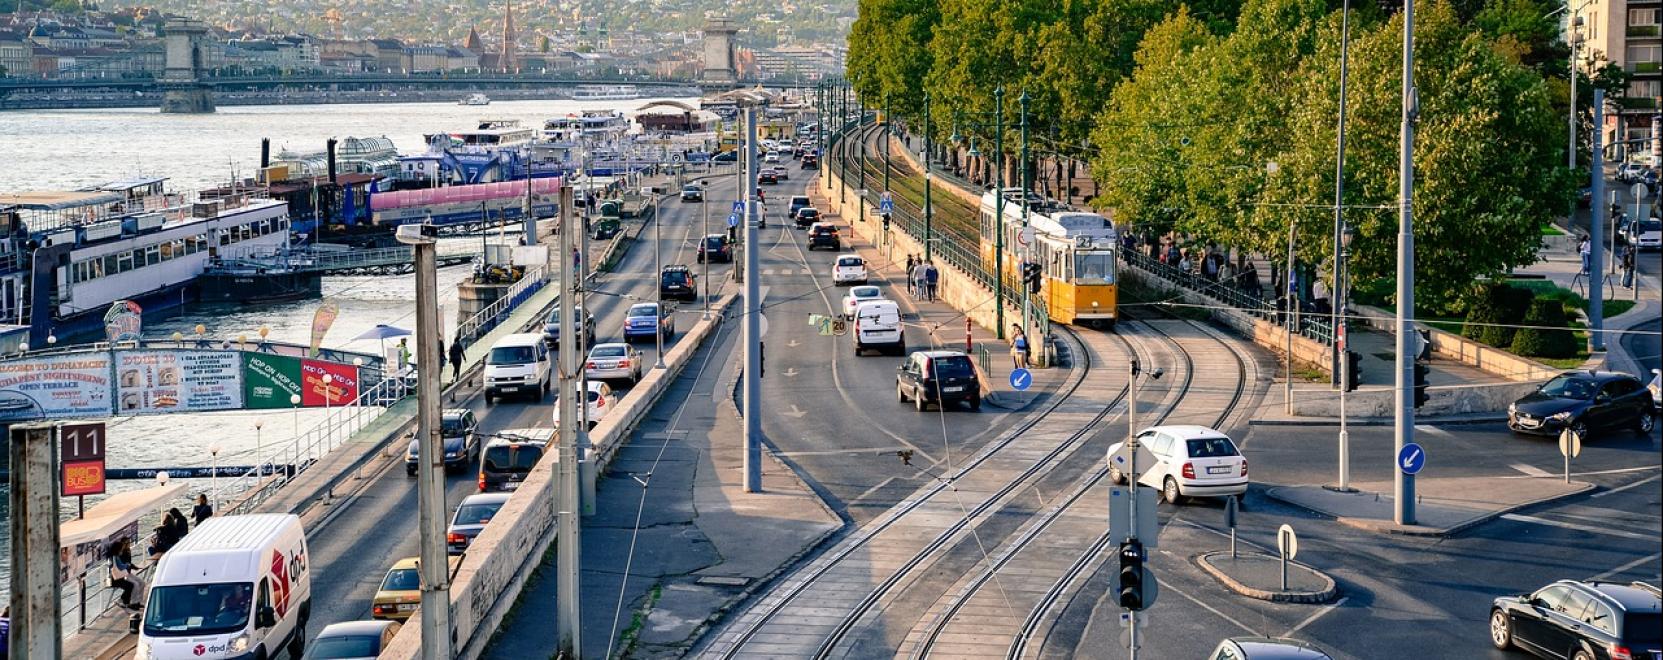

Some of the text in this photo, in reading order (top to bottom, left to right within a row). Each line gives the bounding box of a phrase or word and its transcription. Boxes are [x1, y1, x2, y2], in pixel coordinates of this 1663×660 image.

[468, 169, 479, 183] 7
[833, 321, 845, 331] 20
[19, 381, 79, 391] OPEN TERRACE
[66, 428, 98, 457] 11
[67, 476, 87, 487] BUS
[289, 539, 306, 586] dpd
[208, 644, 226, 654] dpd
